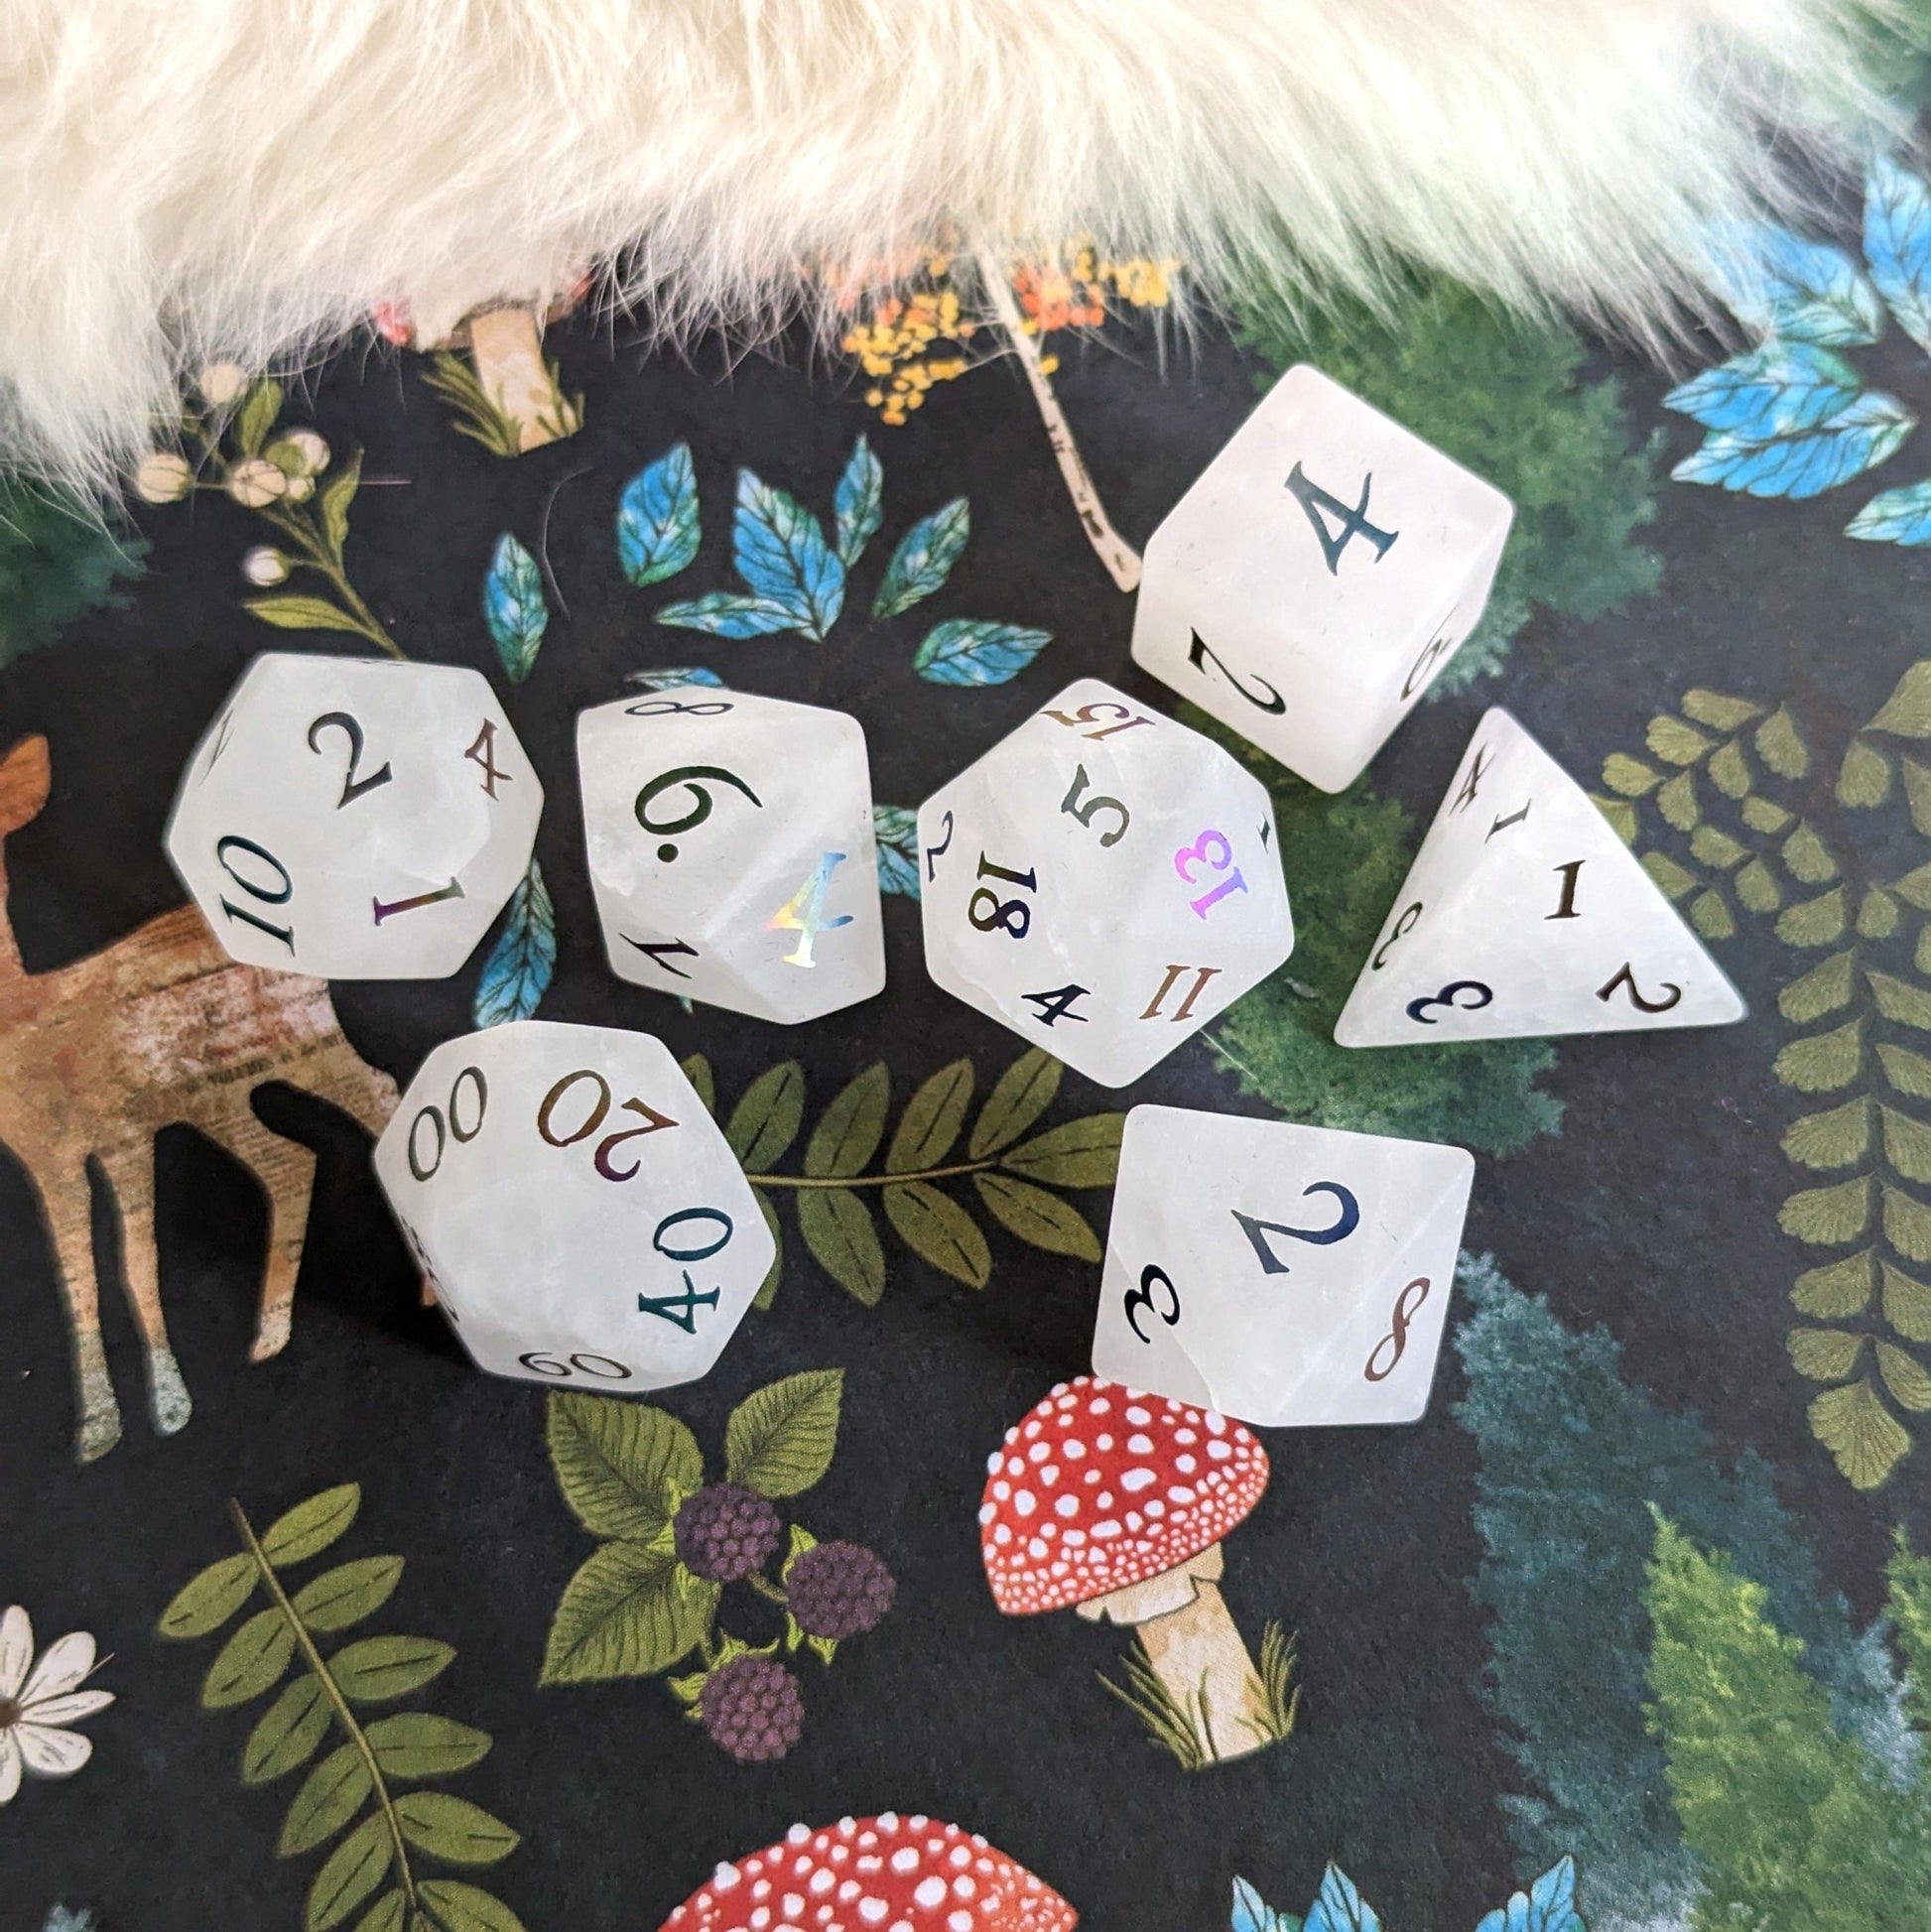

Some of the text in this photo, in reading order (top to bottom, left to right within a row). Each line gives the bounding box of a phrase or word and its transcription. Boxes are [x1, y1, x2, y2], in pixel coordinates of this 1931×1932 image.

[1284, 460, 1399, 576] 4
[625, 702, 734, 716] 8
[1188, 627, 1286, 715] 2
[308, 711, 393, 810] 2
[464, 717, 513, 801] 4
[1039, 703, 1156, 741] 15
[1061, 763, 1130, 847] 5
[1448, 741, 1495, 818] 4
[1484, 798, 1532, 844] 1
[217, 836, 296, 957] 10
[373, 876, 465, 927] 1
[764, 852, 854, 968] 4
[968, 849, 1037, 939] 18
[1174, 830, 1248, 920] 13
[1543, 859, 1587, 920] 1
[1371, 902, 1423, 971] 3
[1021, 984, 1091, 1027] 4
[1139, 965, 1223, 1022] 11
[1406, 980, 1493, 1024] 3
[1596, 962, 1682, 1013] 2
[408, 1066, 488, 1182] 00
[537, 1069, 681, 1183] 20
[1230, 1181, 1360, 1275] 2
[638, 1207, 734, 1335] 40
[1123, 1264, 1181, 1345] 3
[519, 1352, 632, 1378] 60
[1363, 1277, 1431, 1382] 8
